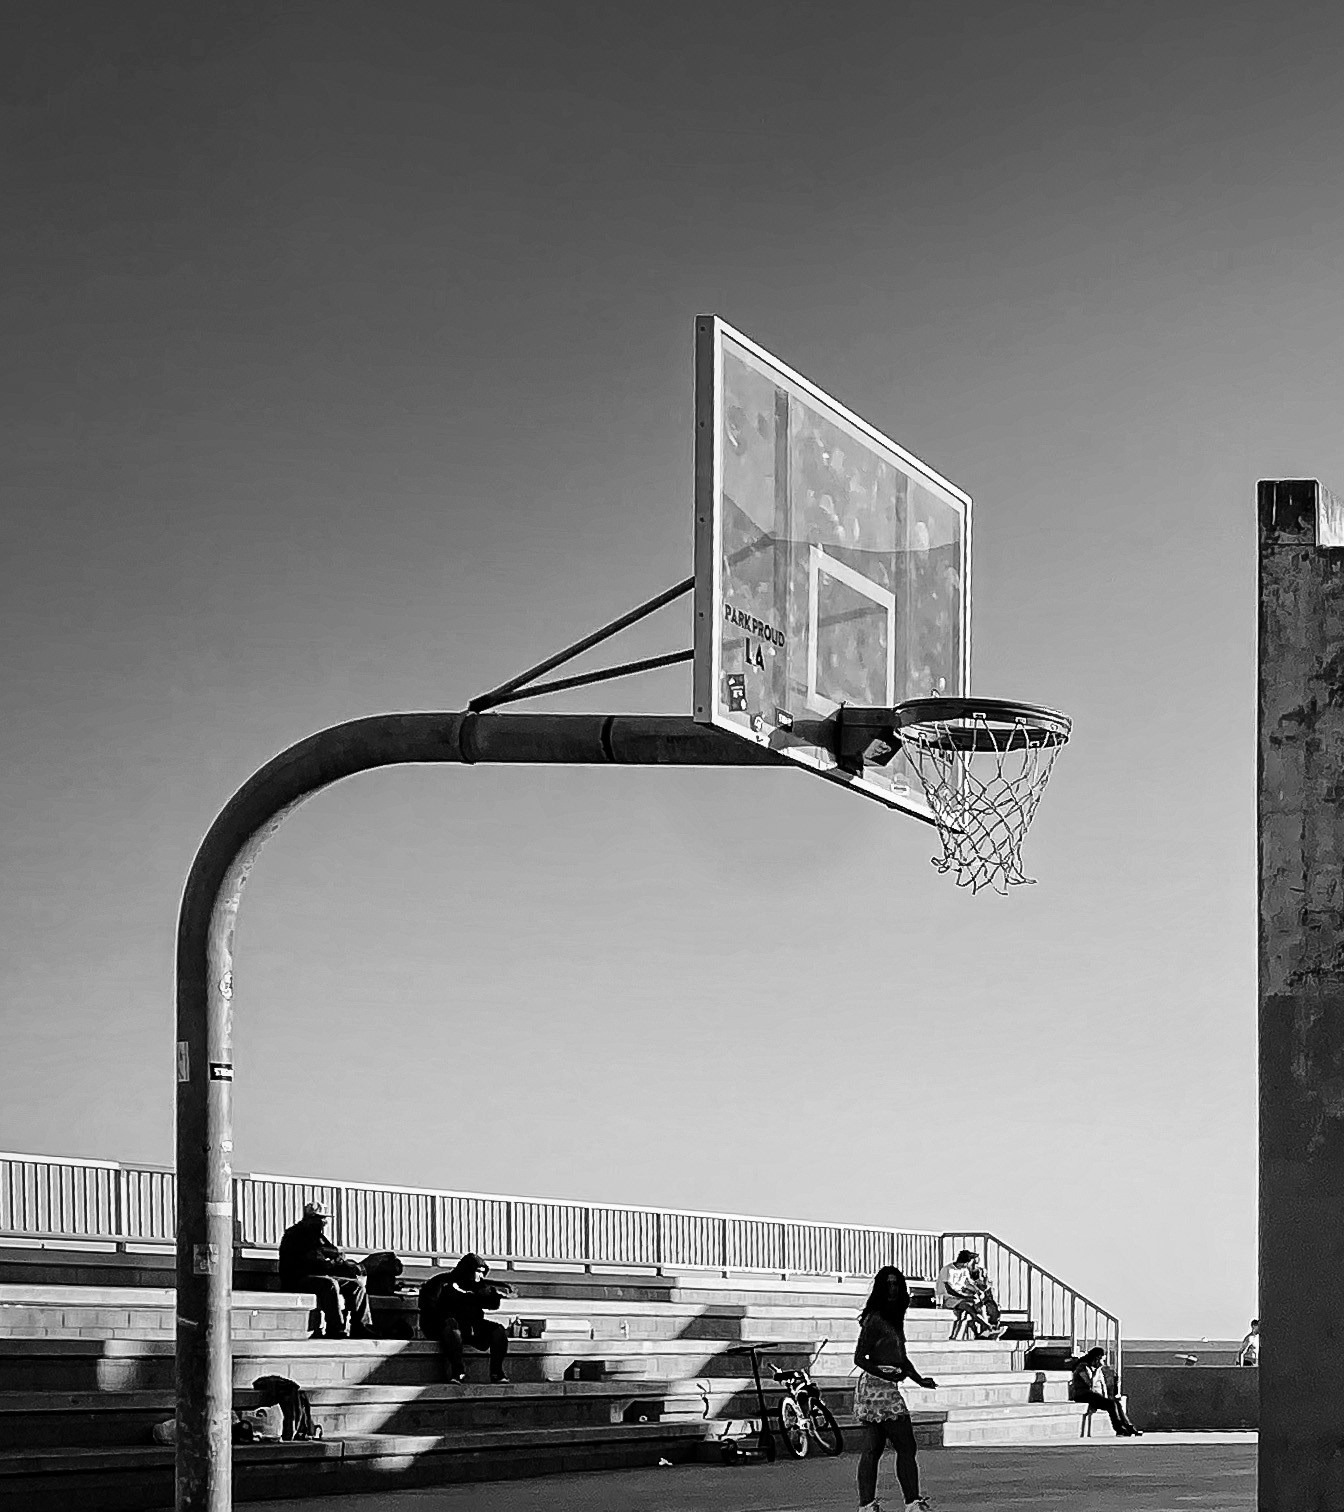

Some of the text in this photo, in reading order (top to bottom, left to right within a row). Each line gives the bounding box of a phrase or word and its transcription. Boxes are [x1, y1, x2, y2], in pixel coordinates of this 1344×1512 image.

[724, 603, 786, 647] PARK PROUD
[744, 637, 765, 672] LA
